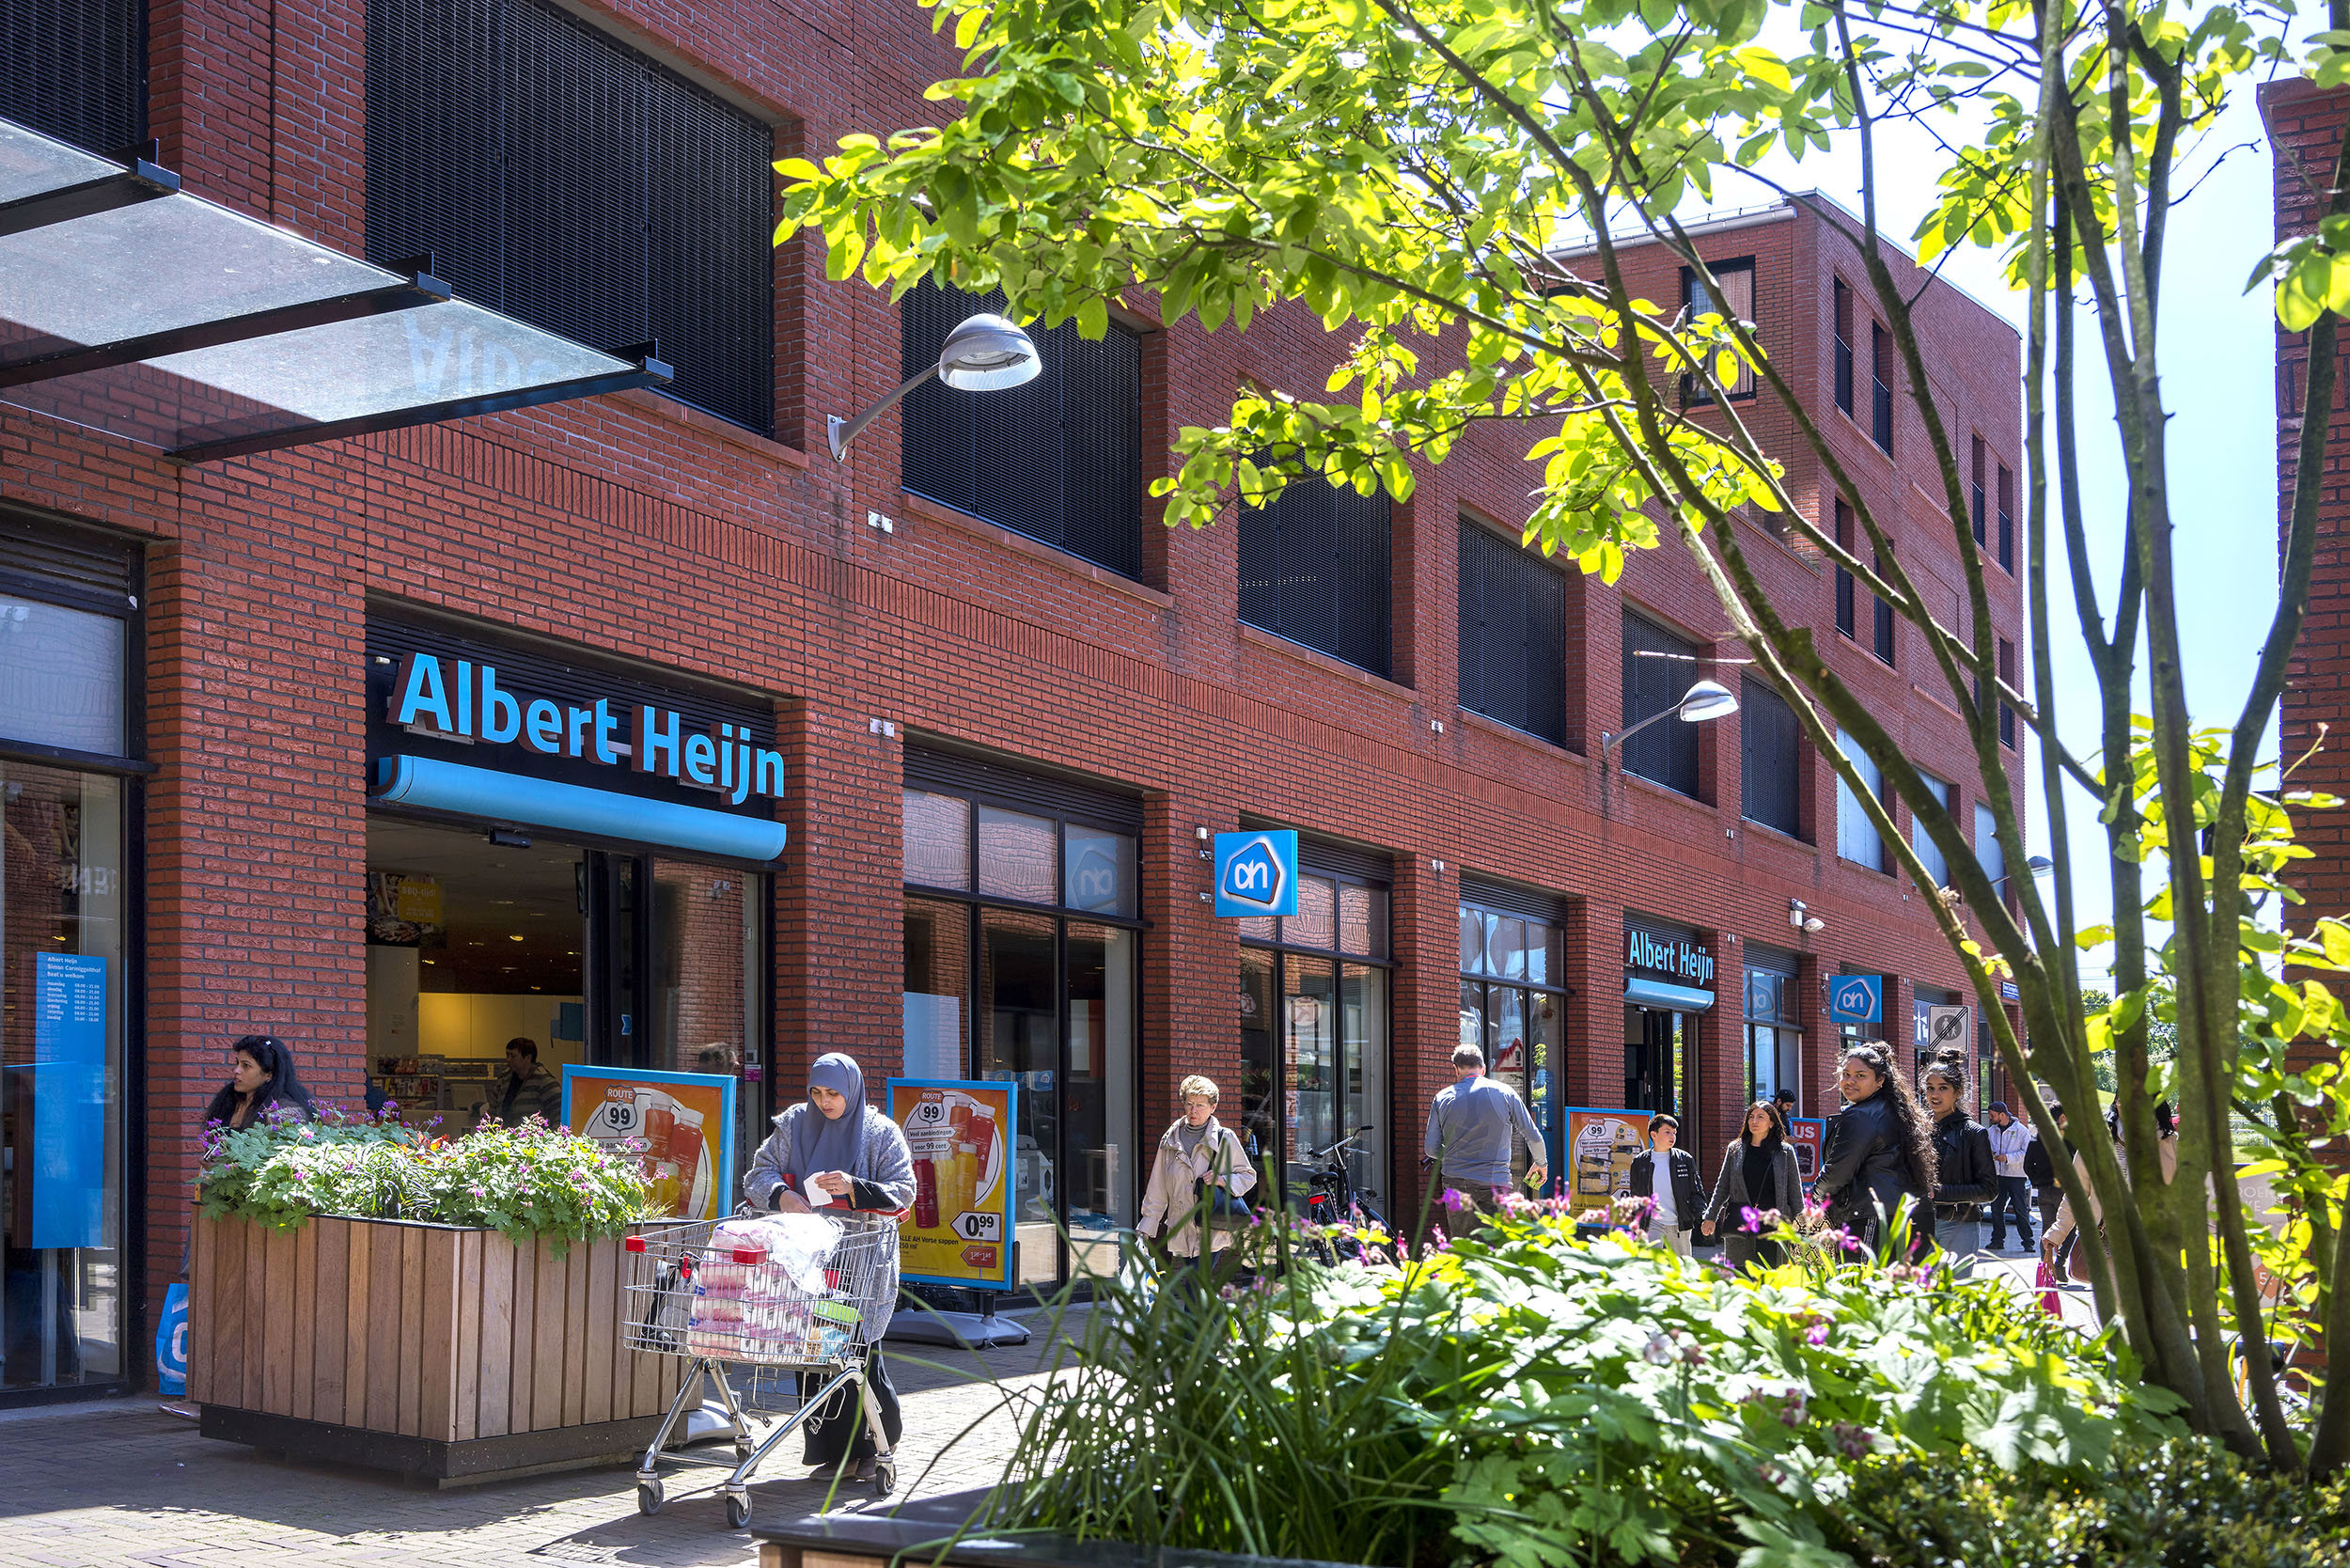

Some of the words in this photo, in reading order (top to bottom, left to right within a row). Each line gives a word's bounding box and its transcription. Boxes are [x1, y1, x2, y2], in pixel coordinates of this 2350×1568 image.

[397, 652, 618, 764] Albert
[641, 705, 785, 806] Heijn
[1629, 931, 1675, 973] Albert
[1679, 942, 1714, 986] Heijn
[607, 1088, 633, 1100] ROUTE
[609, 1106, 631, 1125] 99
[923, 1105, 939, 1119] 99
[965, 1215, 994, 1237] 0.99
